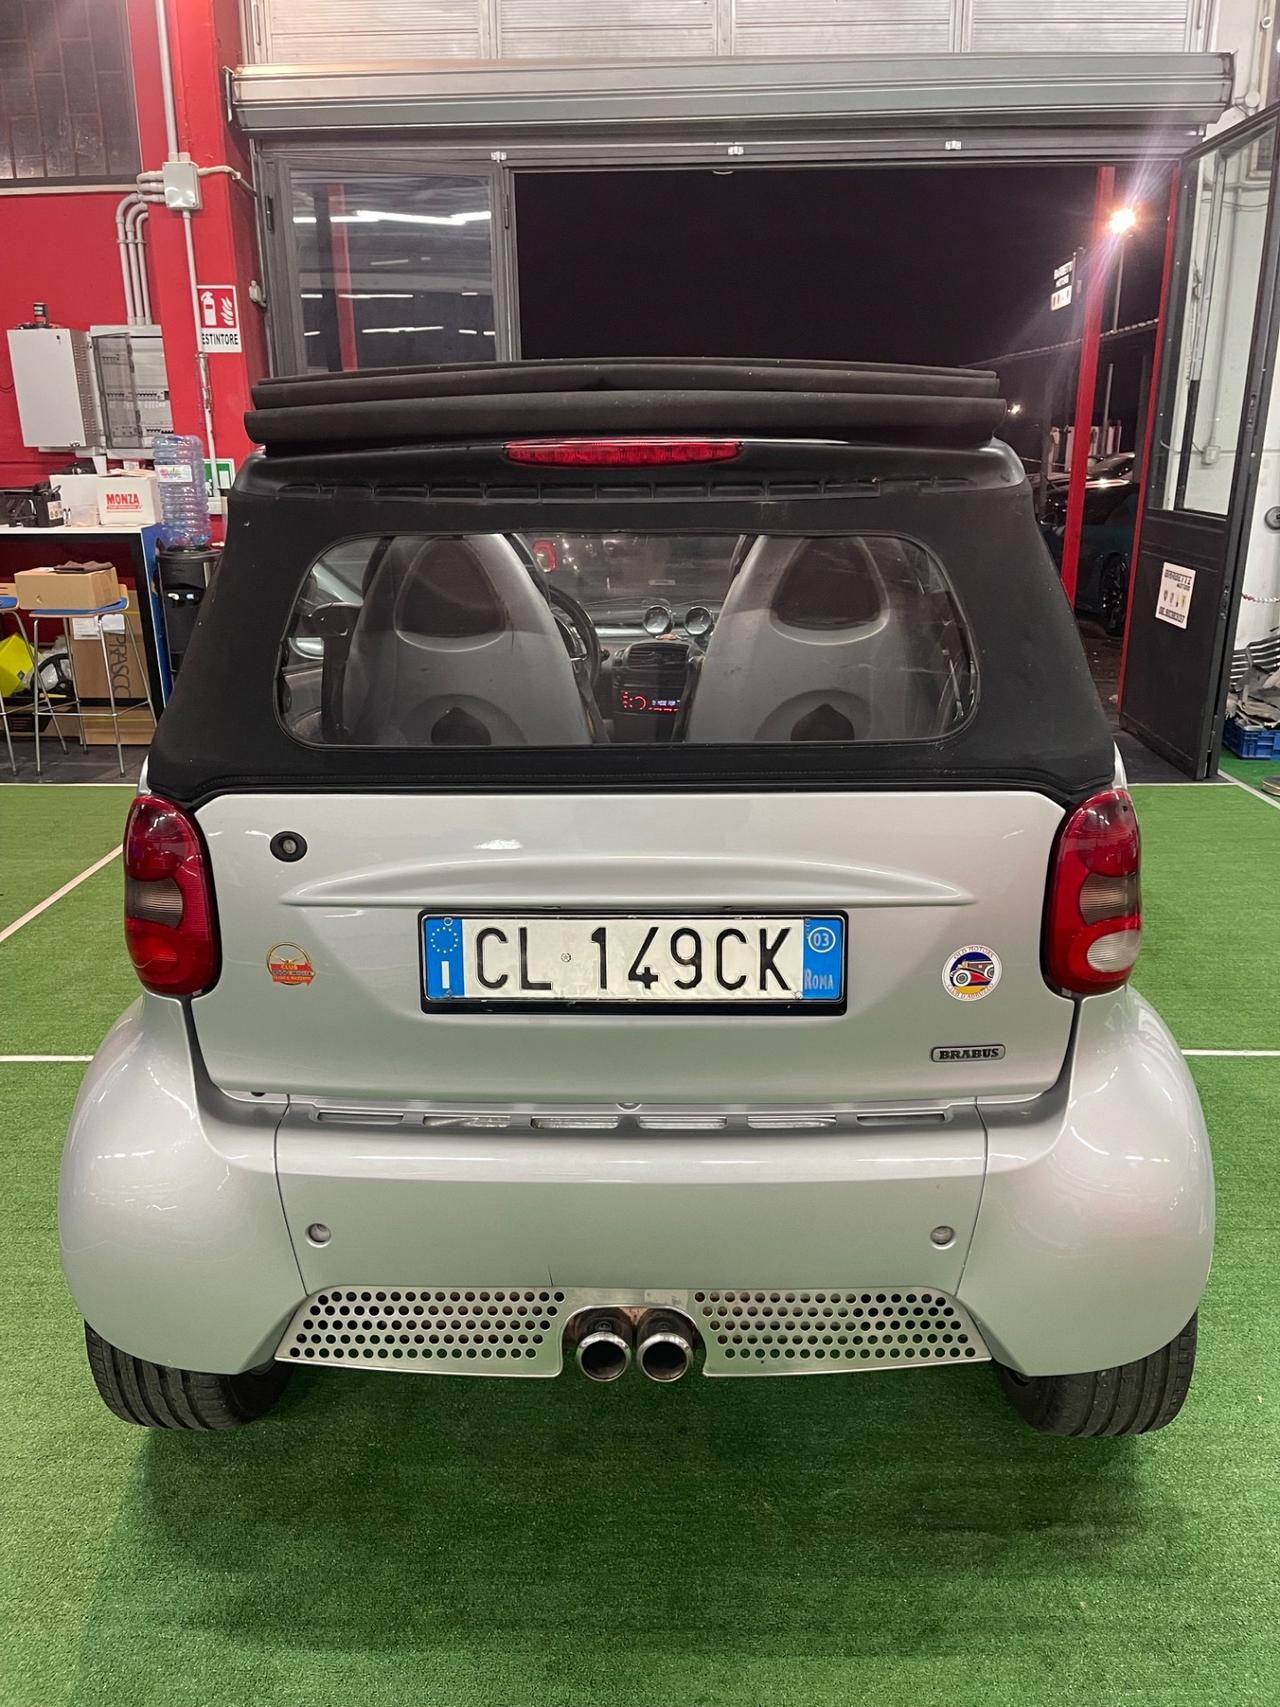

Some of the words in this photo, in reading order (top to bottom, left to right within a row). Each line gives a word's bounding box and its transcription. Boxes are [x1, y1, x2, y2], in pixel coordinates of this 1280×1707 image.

[201, 333, 239, 345] ESTINTORE
[106, 493, 140, 505] MONZA
[813, 932, 830, 947] 03
[476, 927, 552, 990] CL
[591, 926, 792, 991] 149CK
[939, 1047, 1000, 1060] BRABUS
